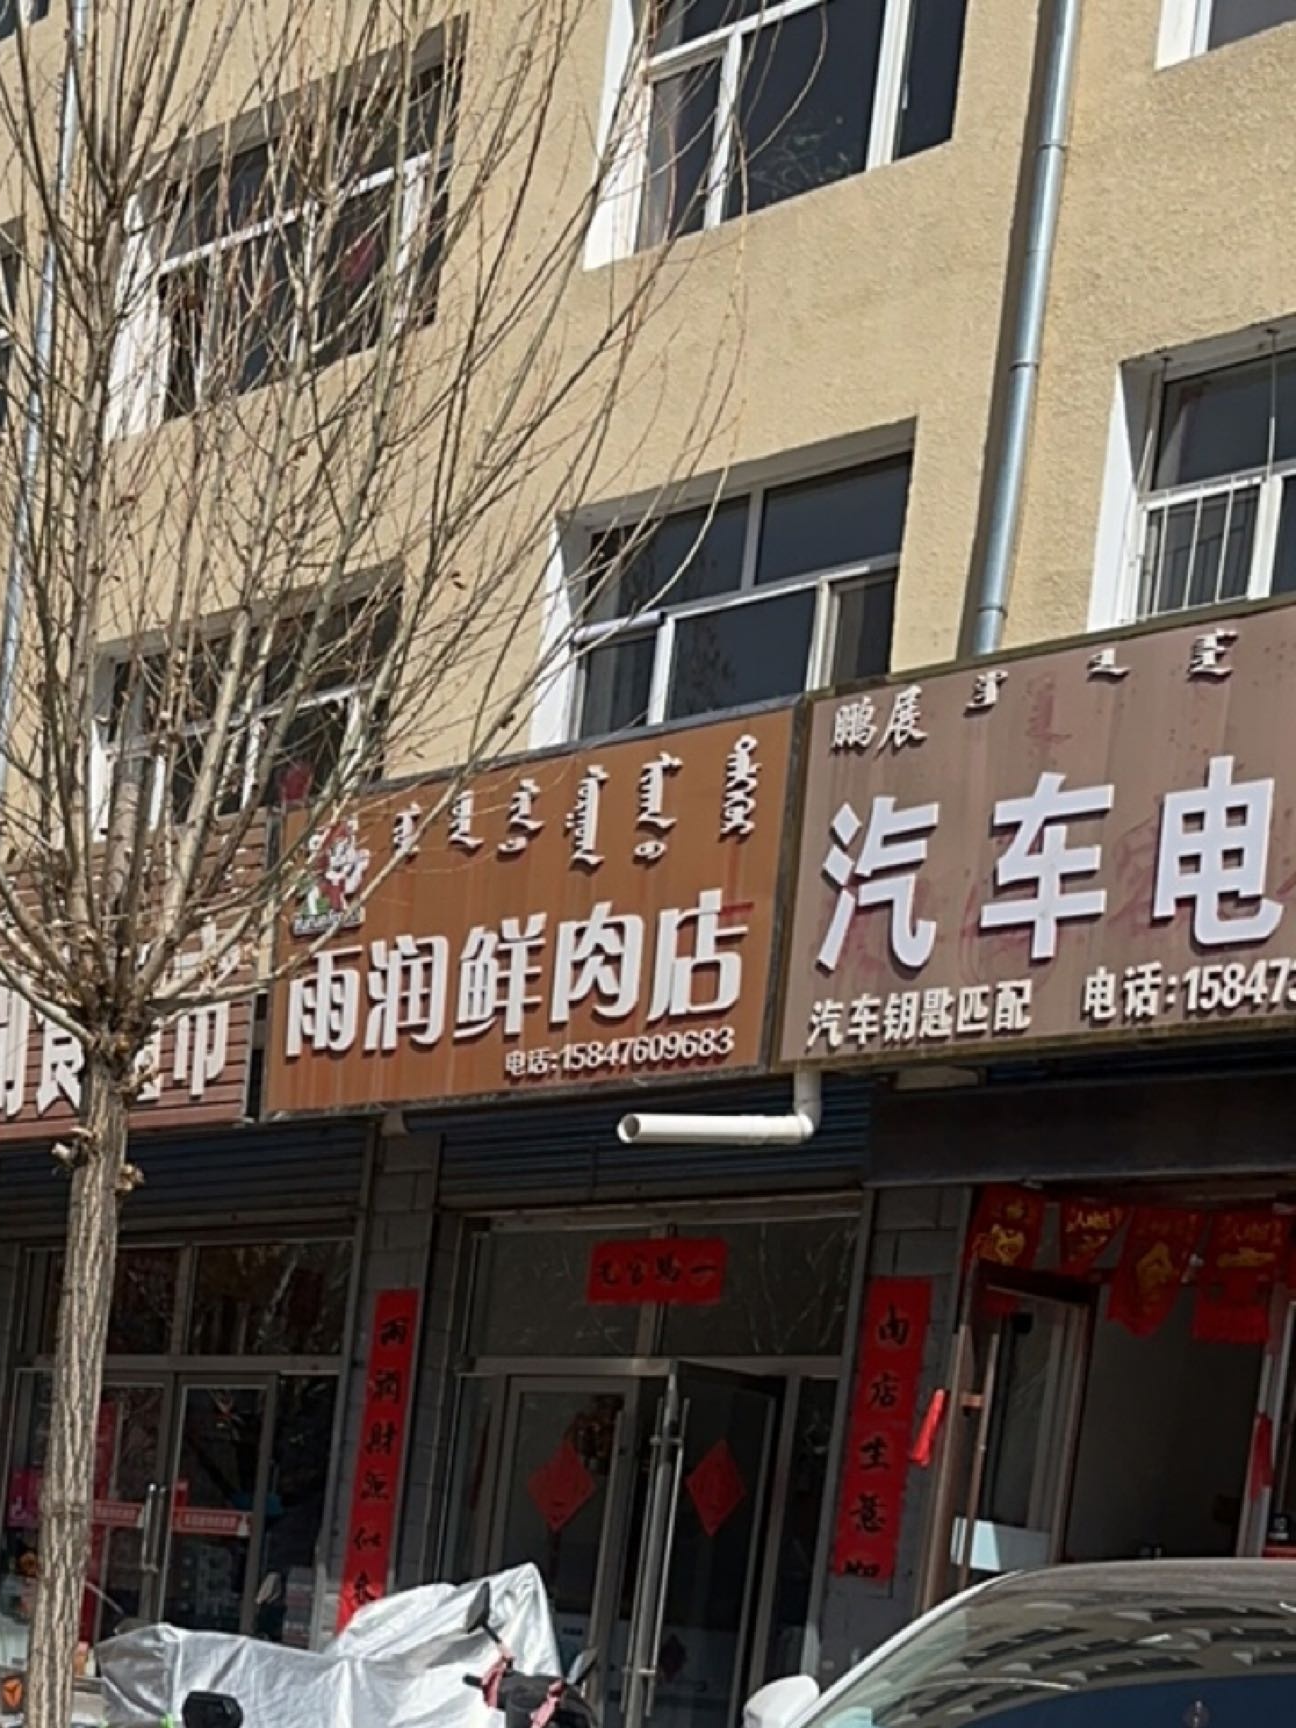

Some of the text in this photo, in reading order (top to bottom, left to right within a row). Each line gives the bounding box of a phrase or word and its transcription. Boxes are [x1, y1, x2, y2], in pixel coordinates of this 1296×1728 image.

[816, 755, 1284, 971] 汽车电
[285, 888, 751, 1059] 雨润鲜肉店
[807, 979, 1032, 1049] 汽车钥匙匹配
[505, 1026, 735, 1076] 电话:15847609683
